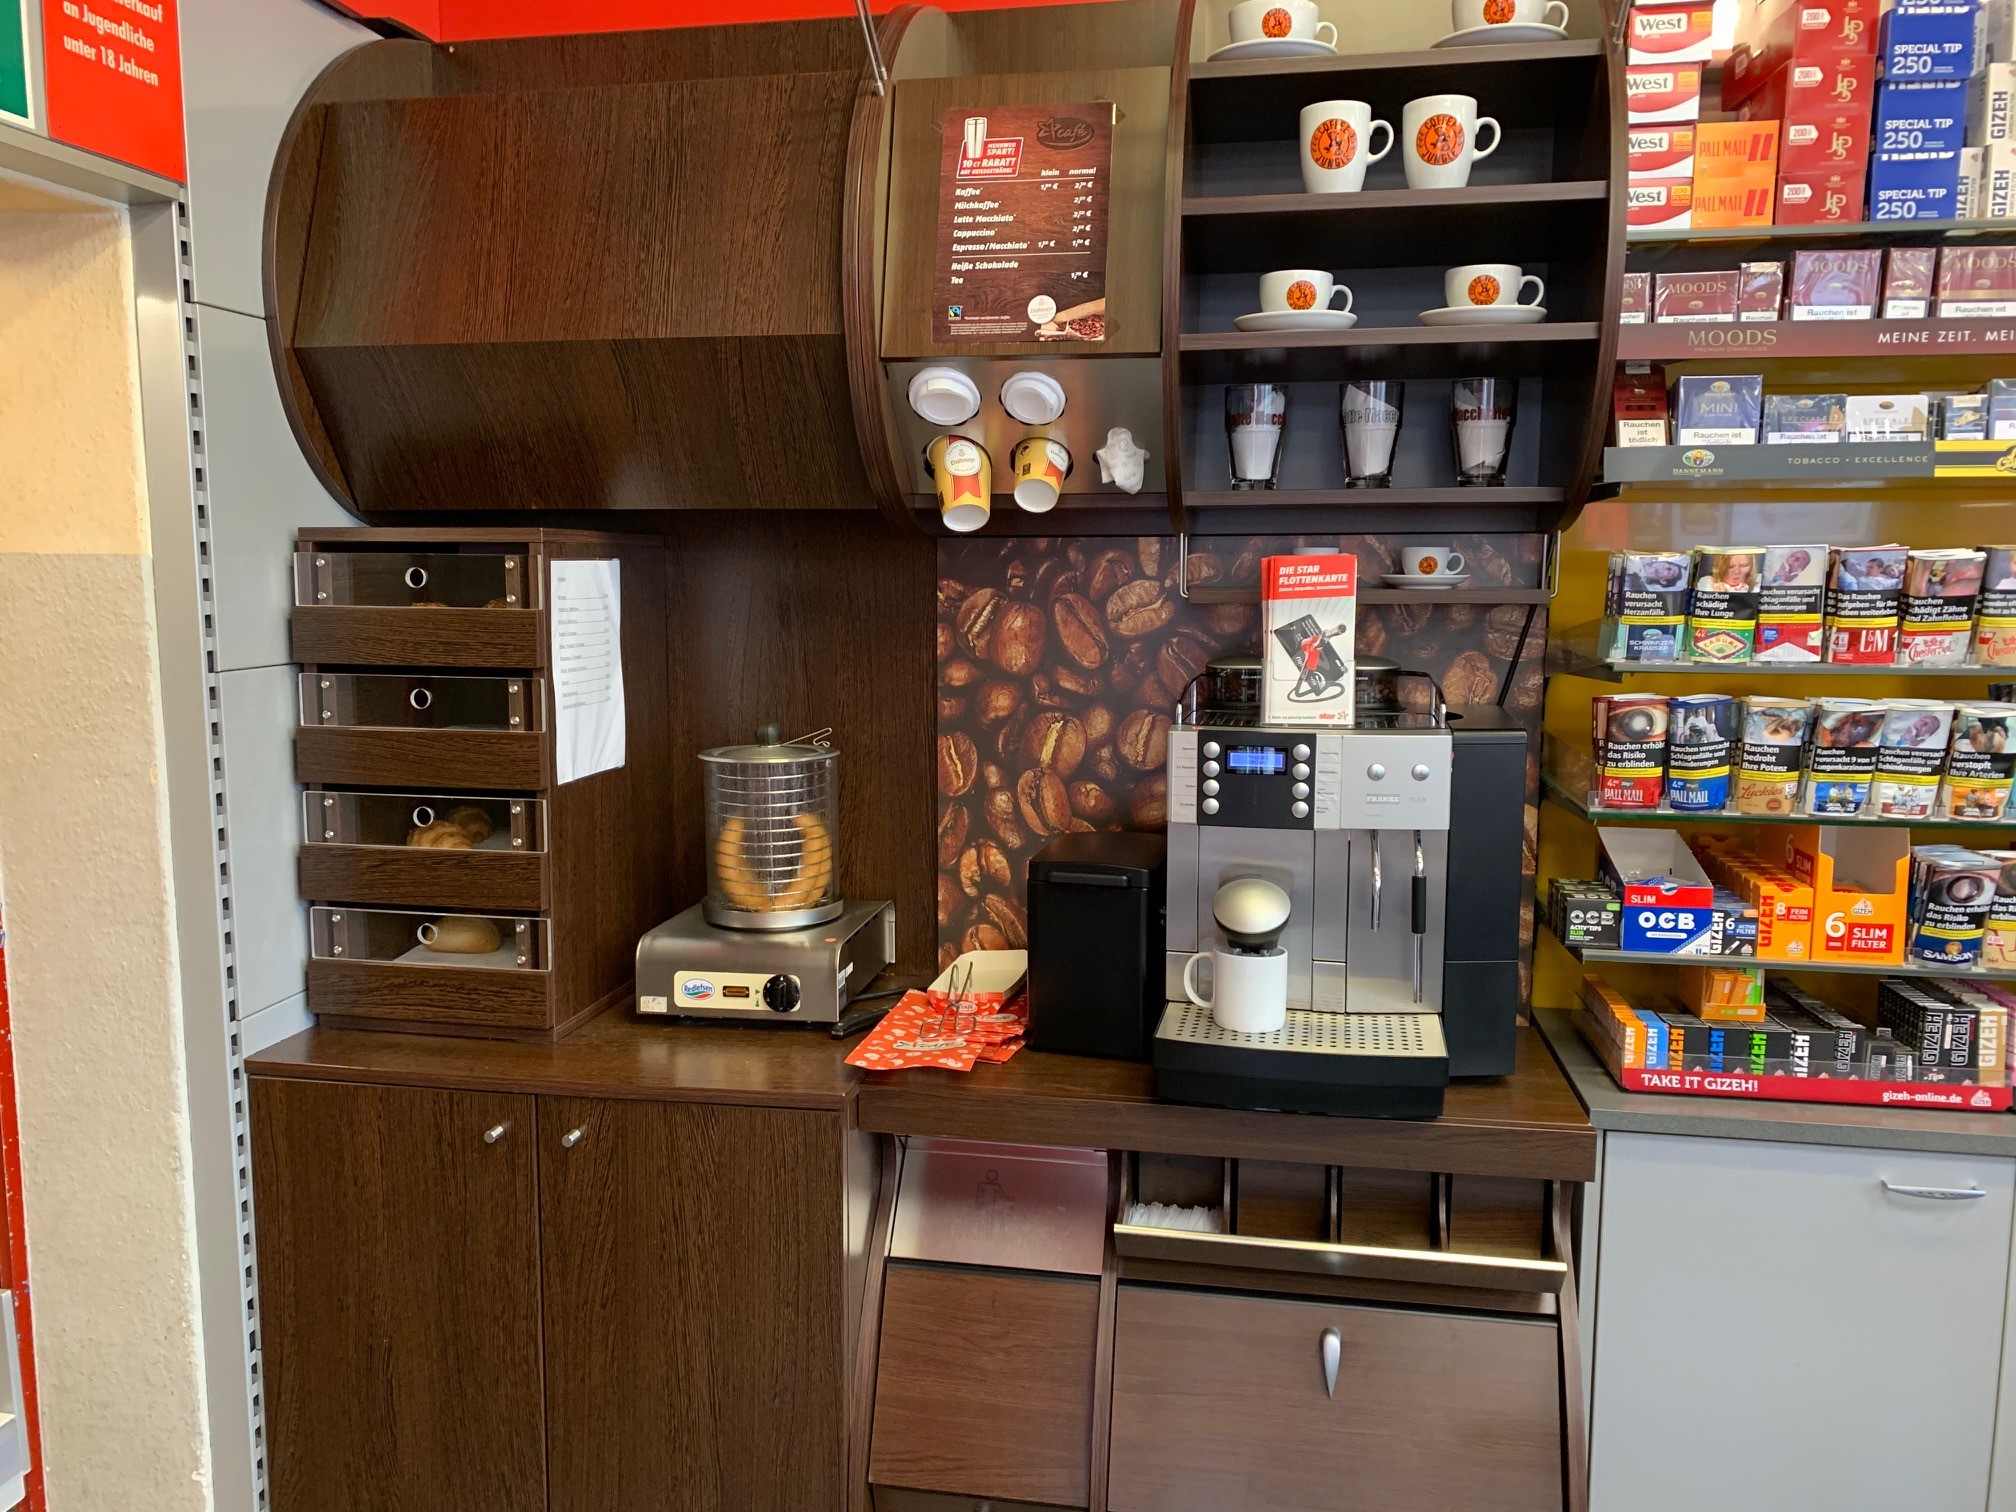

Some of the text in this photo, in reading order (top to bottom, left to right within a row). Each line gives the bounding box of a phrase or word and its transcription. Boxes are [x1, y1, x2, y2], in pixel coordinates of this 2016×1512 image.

[63, 1, 154, 52] an Jugendliche
[1639, 16, 1683, 32] West
[1893, 43, 1963, 55] SPECIAL TIP
[63, 34, 159, 87] unter 18 Jahren
[1891, 56, 1932, 75] 250
[1627, 77, 1669, 91] West
[1990, 90, 2008, 140] GIZEH
[1884, 118, 1954, 130] SPECIAL TIP
[1882, 130, 1923, 149] 250
[1699, 138, 1748, 158] PALL MALL
[962, 159, 974, 168] 10
[981, 157, 1017, 167] RABATT
[1315, 154, 1352, 169] JUNGLE
[1421, 150, 1460, 166] JUNGLE
[1040, 167, 1097, 176] klein normal
[1878, 188, 1947, 200] SPECIAL TIP
[1991, 169, 2010, 218] GIZEH
[1694, 193, 1744, 213] PALL MALL
[1876, 201, 1917, 219] 250
[953, 215, 974, 224] Latte
[951, 261, 1019, 271] Heiße Schokolade
[1807, 259, 1869, 273] MOODS
[950, 276, 964, 285] Tee
[1667, 281, 1727, 294] MOODS
[1807, 308, 1844, 316] Rauchen
[1687, 328, 1777, 347] MOODS
[1877, 330, 1977, 344] MEINE ZEIT.
[1700, 402, 1739, 414] MINI
[1637, 428, 1648, 436] ist
[1693, 430, 1742, 439] Rauchen ist
[1787, 455, 1929, 465] TOBACCO EXCELLENCE
[1672, 468, 1724, 476] DANNEMANN
[1279, 565, 1320, 575] DIE STAR
[1278, 573, 1349, 585] FLOTTENKARTE
[1625, 591, 1657, 599] Rauchen
[1697, 591, 1730, 600] Rauchen
[1802, 595, 1815, 603] und
[1851, 592, 1882, 600] Rauchen
[1624, 600, 1663, 608] verursacht
[1695, 599, 1728, 609] schädigt
[1908, 597, 1944, 606] Rauchen
[1623, 608, 1666, 616] Herzanfälle
[1695, 609, 1735, 618] Ihre Lunge
[1942, 605, 1968, 613] Zähne
[1921, 613, 1969, 622] Zahnfleisch
[1860, 628, 1889, 653] L&M
[1318, 712, 1336, 720] star
[1607, 740, 1666, 751] Rauchen erhöht
[1670, 744, 1699, 752] Rauchen
[1744, 744, 1780, 754] Rauchen
[1607, 750, 1647, 759] das Risiko
[1670, 749, 1726, 760] Schlaganfälle und
[1743, 752, 1777, 762] bedroht
[1879, 747, 1910, 756] Rauchen
[1953, 751, 1991, 760] Rauchen
[1616, 759, 1655, 768] erblinden
[1670, 758, 1719, 768] Behinderungen
[1815, 755, 1851, 763] verursacht
[1878, 755, 1941, 766] Schlaganfälle und
[1742, 761, 1788, 772] Ihre Potenz
[1877, 763, 1932, 774] Behinderungen
[1951, 760, 1992, 770] verstopft
[1950, 768, 2005, 779] Ihre Arterien
[1604, 788, 1644, 802] PALL MALL
[1670, 789, 1709, 803] PALL MALL
[1737, 784, 1784, 799] Luckies
[1366, 794, 1400, 804] FRANKE
[1630, 894, 1656, 904] SLIM
[1776, 901, 1787, 916] 8
[1853, 907, 1873, 915] GIZEH
[1927, 902, 1966, 913] Rauchen
[1569, 909, 1616, 926] OCB
[1638, 911, 1697, 931] OCB
[1758, 895, 1775, 947] GIZEH
[1925, 911, 1970, 922] das Risiko
[1725, 917, 1735, 930] 6
[1825, 912, 1888, 939] 6 SLIM
[1923, 920, 1976, 930] zu erblinden
[1710, 912, 1725, 954] GIZEH
[1851, 939, 1887, 950] FILTER
[1922, 949, 1974, 962] SAMSON
[1922, 1012, 1944, 1065] GIZEH
[1950, 1013, 1971, 1066] GIZEH
[1979, 1015, 1998, 1067] GIZEH
[1623, 1026, 1636, 1064] GIZEH
[1646, 1027, 1659, 1065] GIZEH
[1836, 1030, 1853, 1072] GIZEH
[1641, 1073, 1759, 1092] TAKE IT GIZEH!
[1882, 1089, 1963, 1104] gizeh-online.de
